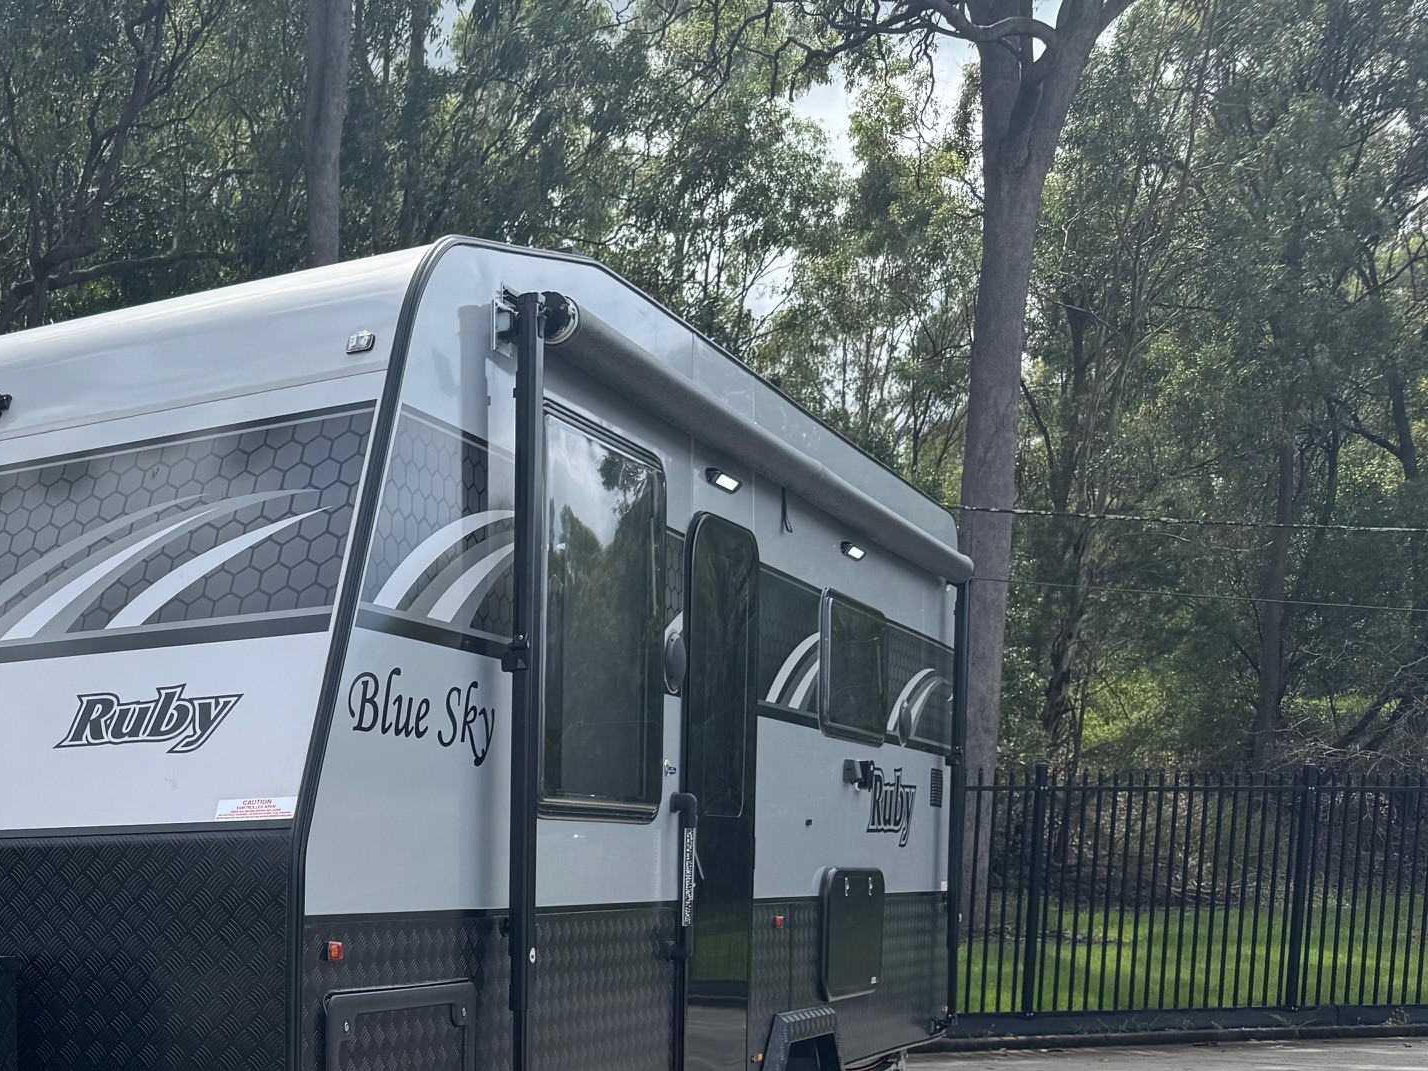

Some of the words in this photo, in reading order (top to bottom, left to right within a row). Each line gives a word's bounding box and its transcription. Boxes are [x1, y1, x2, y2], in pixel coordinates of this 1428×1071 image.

[52, 682, 244, 754] Ruby
[347, 667, 430, 739] Blue
[437, 680, 495, 767] Sky
[866, 766, 917, 847] Ruby
